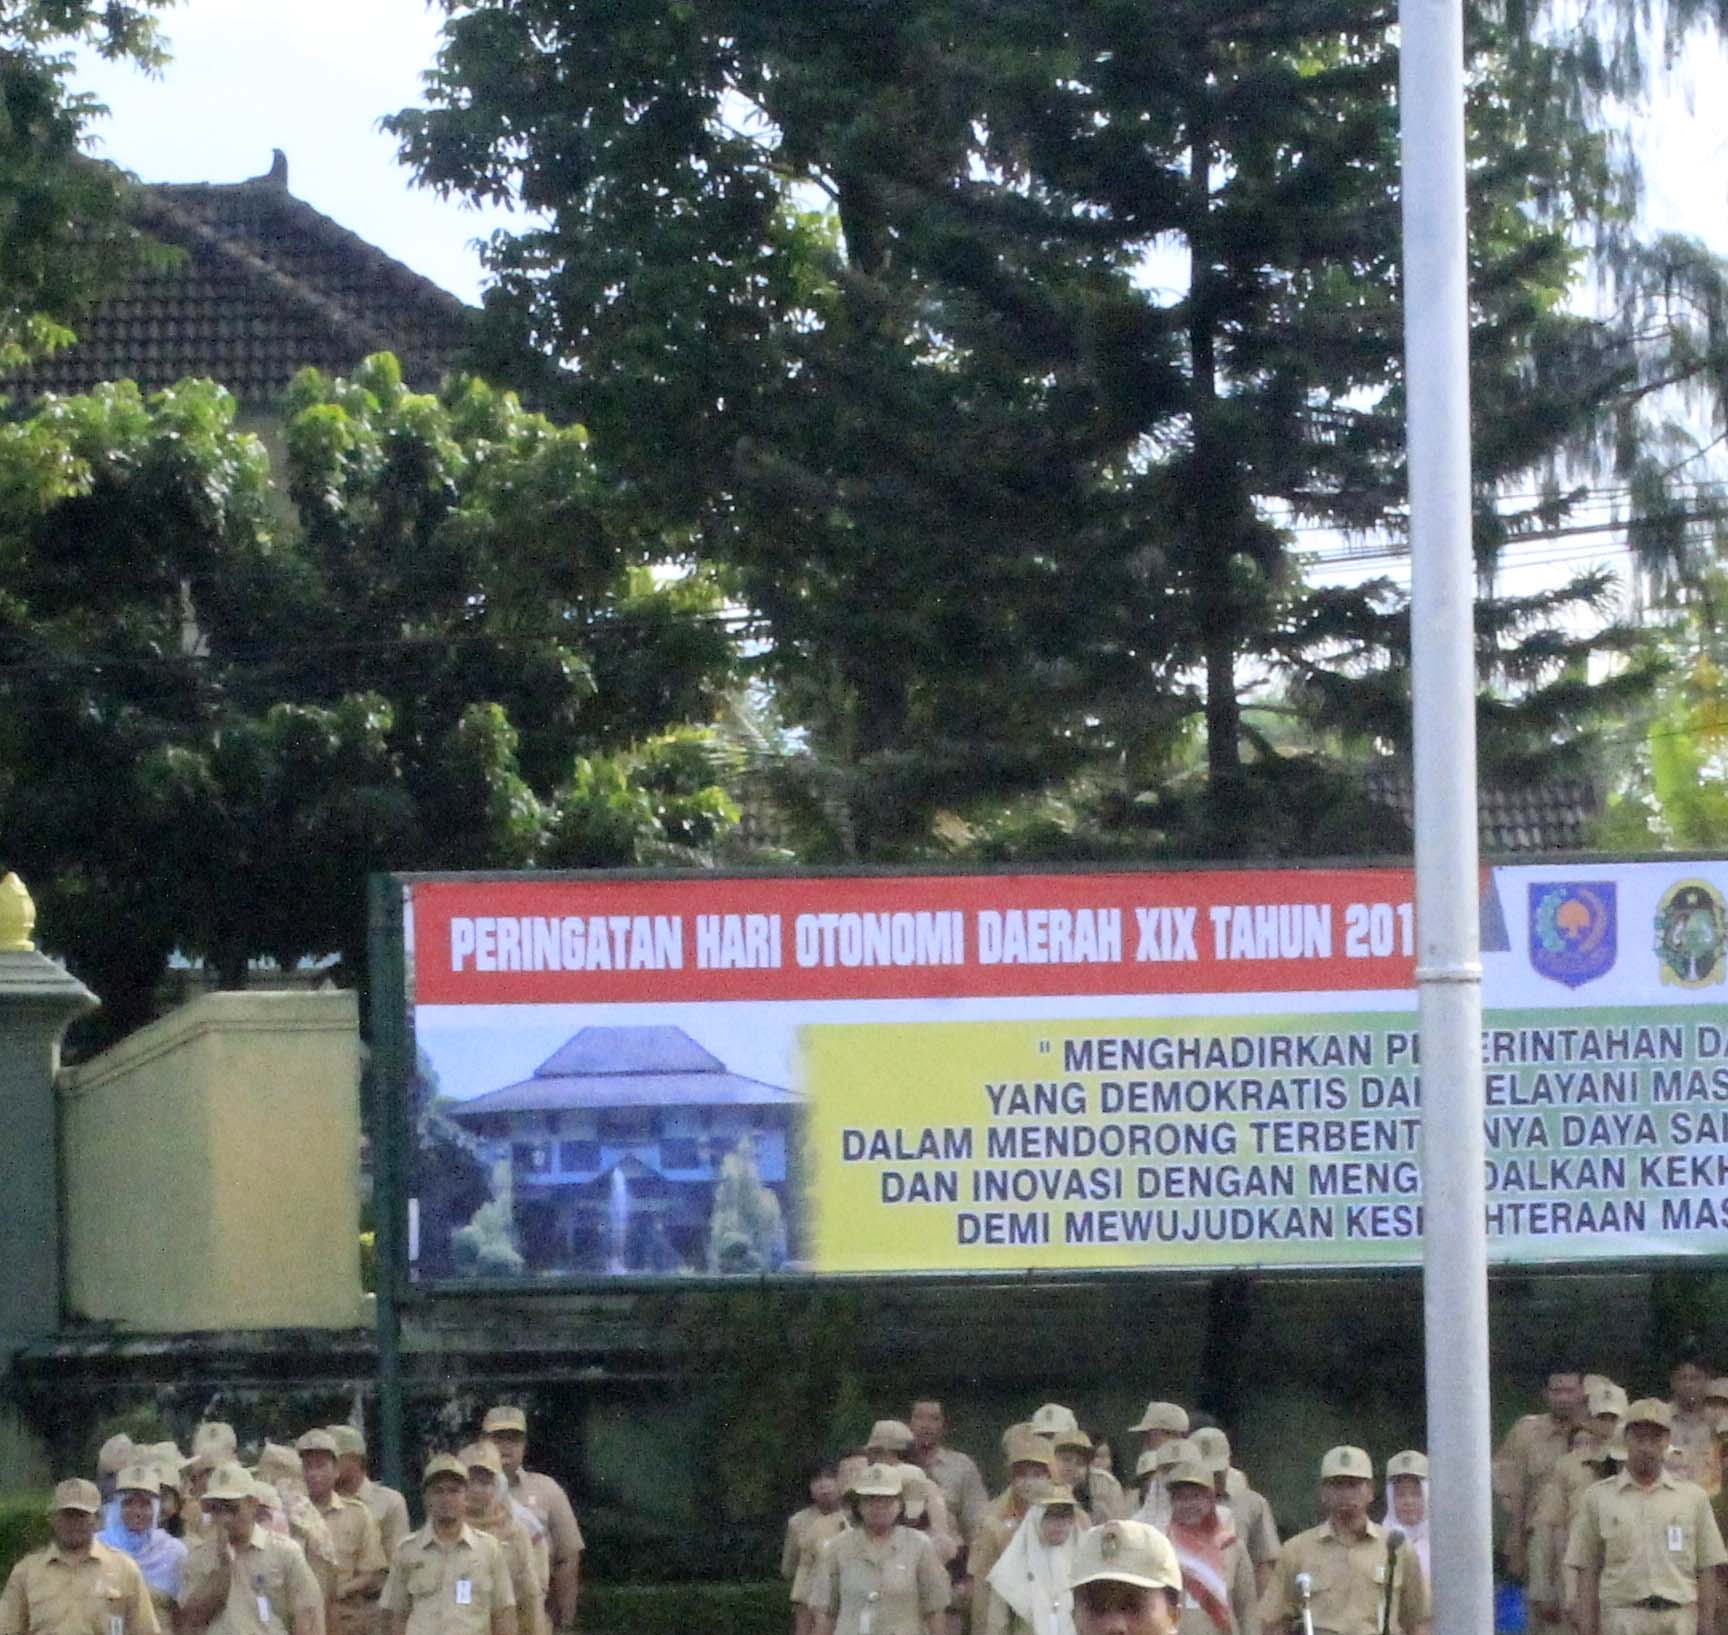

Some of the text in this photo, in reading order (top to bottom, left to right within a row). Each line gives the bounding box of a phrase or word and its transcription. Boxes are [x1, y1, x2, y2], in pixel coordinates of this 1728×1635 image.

[451, 902, 1415, 971] PERINGATAN HARI OTONOMI DAERAH XIX TAHUN 201
[1064, 1034, 1373, 1072] MENGHADIRKAN
[985, 1082, 1087, 1116] YANG
[1100, 1077, 1348, 1113] DEMOKRATIS
[1361, 1076, 1420, 1109] DA
[1485, 1071, 1638, 1105] ELAYANI
[842, 1127, 973, 1161] DALAM
[988, 1122, 1237, 1159] MENDORONG
[1563, 1114, 1658, 1147] DAYA
[881, 1171, 959, 1203] DAN
[973, 1167, 1122, 1202] INOVASI
[1138, 1165, 1294, 1199] DENGAN
[957, 1211, 1050, 1245] DEMI
[1065, 1206, 1333, 1243] MEWUJUDKAN
